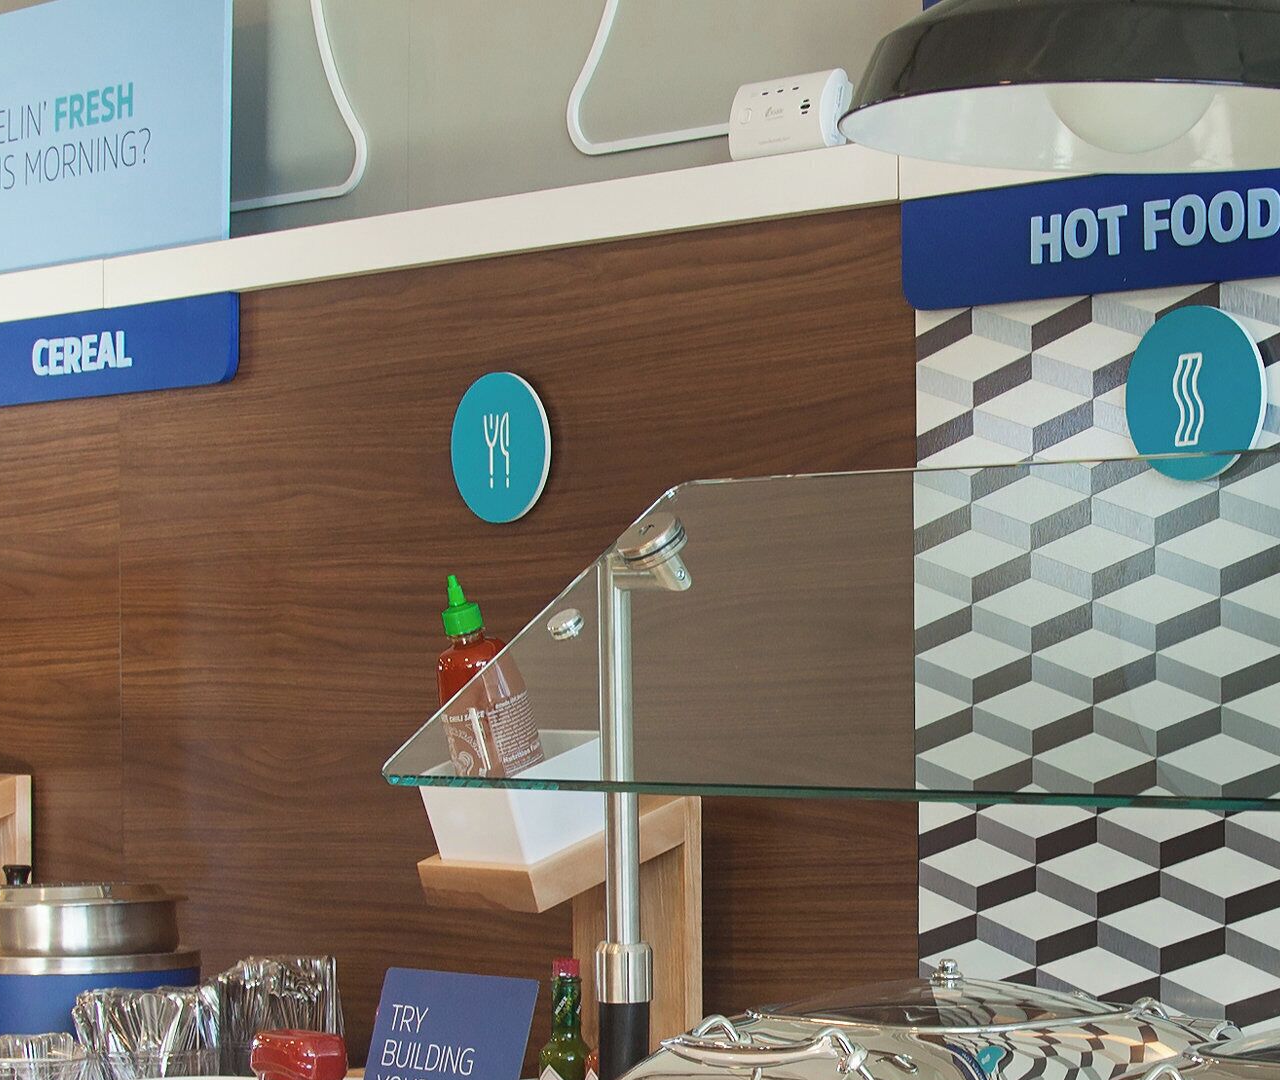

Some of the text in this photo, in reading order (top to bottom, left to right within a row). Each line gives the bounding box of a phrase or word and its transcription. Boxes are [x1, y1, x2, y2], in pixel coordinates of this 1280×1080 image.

[54, 82, 134, 133] FRESH
[25, 127, 152, 186] MORNING?
[1030, 204, 1128, 265] HOT
[31, 330, 133, 377] CEREAL
[391, 1004, 429, 1034] TRY
[381, 1039, 475, 1076] BUILDING
